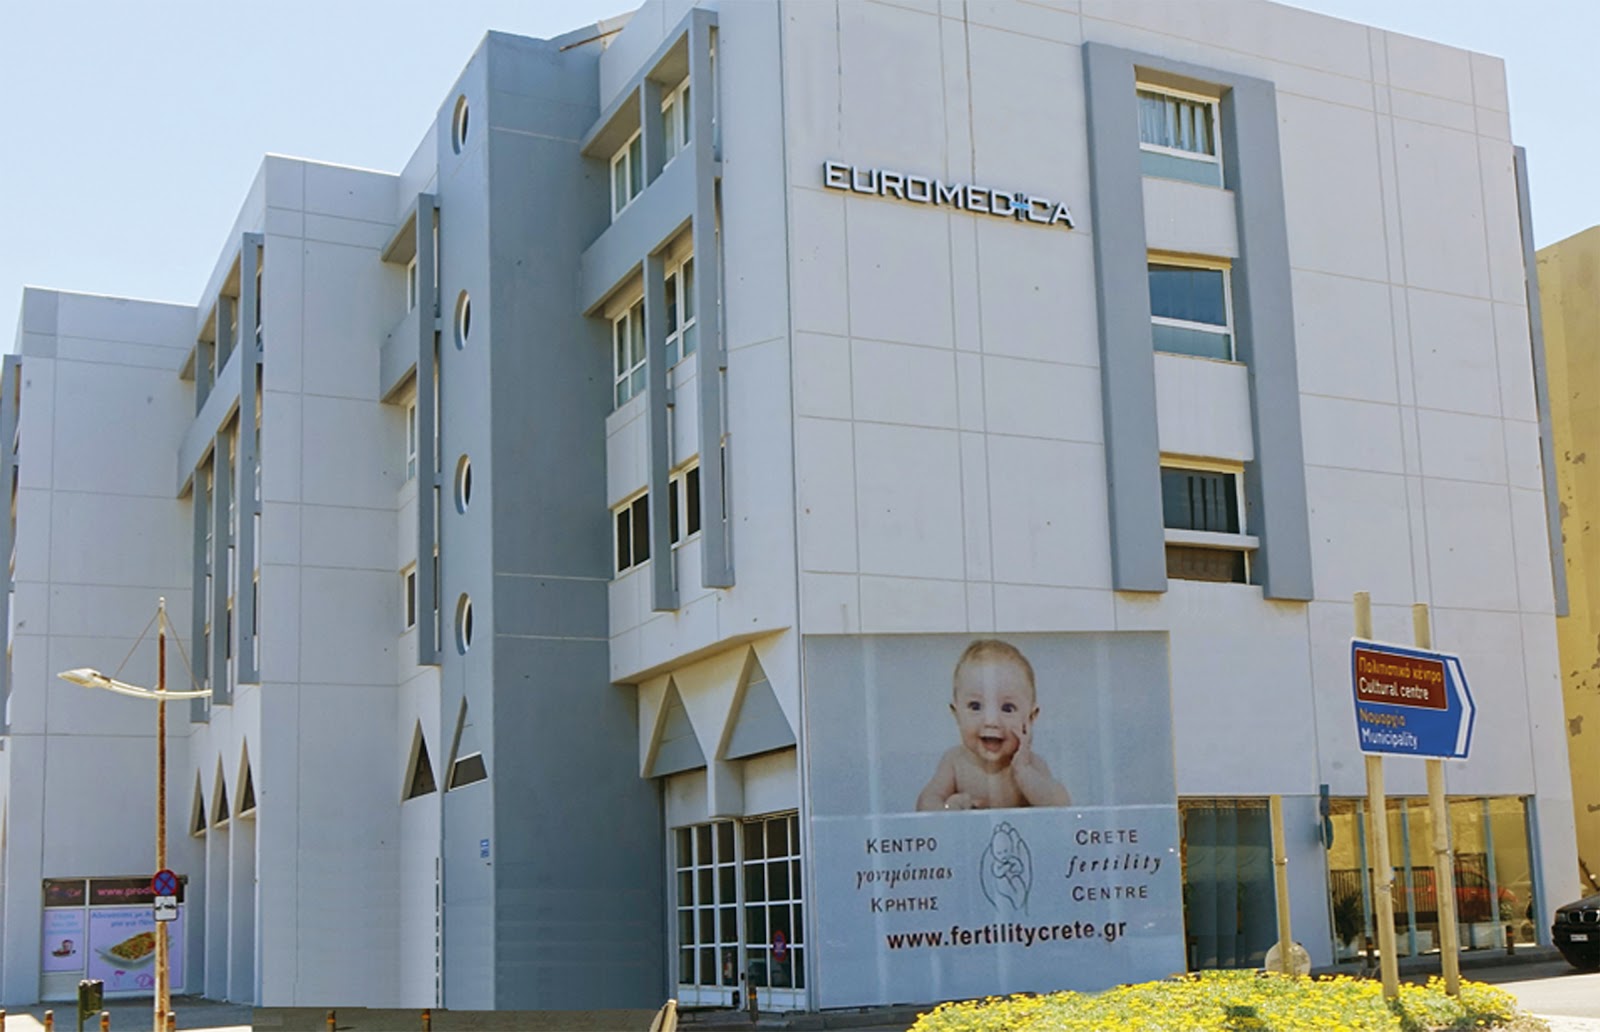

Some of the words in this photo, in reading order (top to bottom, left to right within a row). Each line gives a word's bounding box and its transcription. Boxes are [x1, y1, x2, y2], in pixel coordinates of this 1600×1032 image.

[823, 160, 1075, 229] EUROMEDICA
[1359, 676, 1399, 697] Cultural
[1400, 684, 1429, 700] centre
[1361, 727, 1418, 750] Municipality
[866, 837, 938, 854] ΚΕΝΤΡΟ
[1075, 829, 1138, 845] CRETE
[1065, 853, 1162, 879] fertility
[871, 896, 939, 913] ΚΡΗΤΗΣ
[1072, 885, 1148, 902] CENTRE
[887, 919, 1127, 949] www.fertilitycrete.gr
